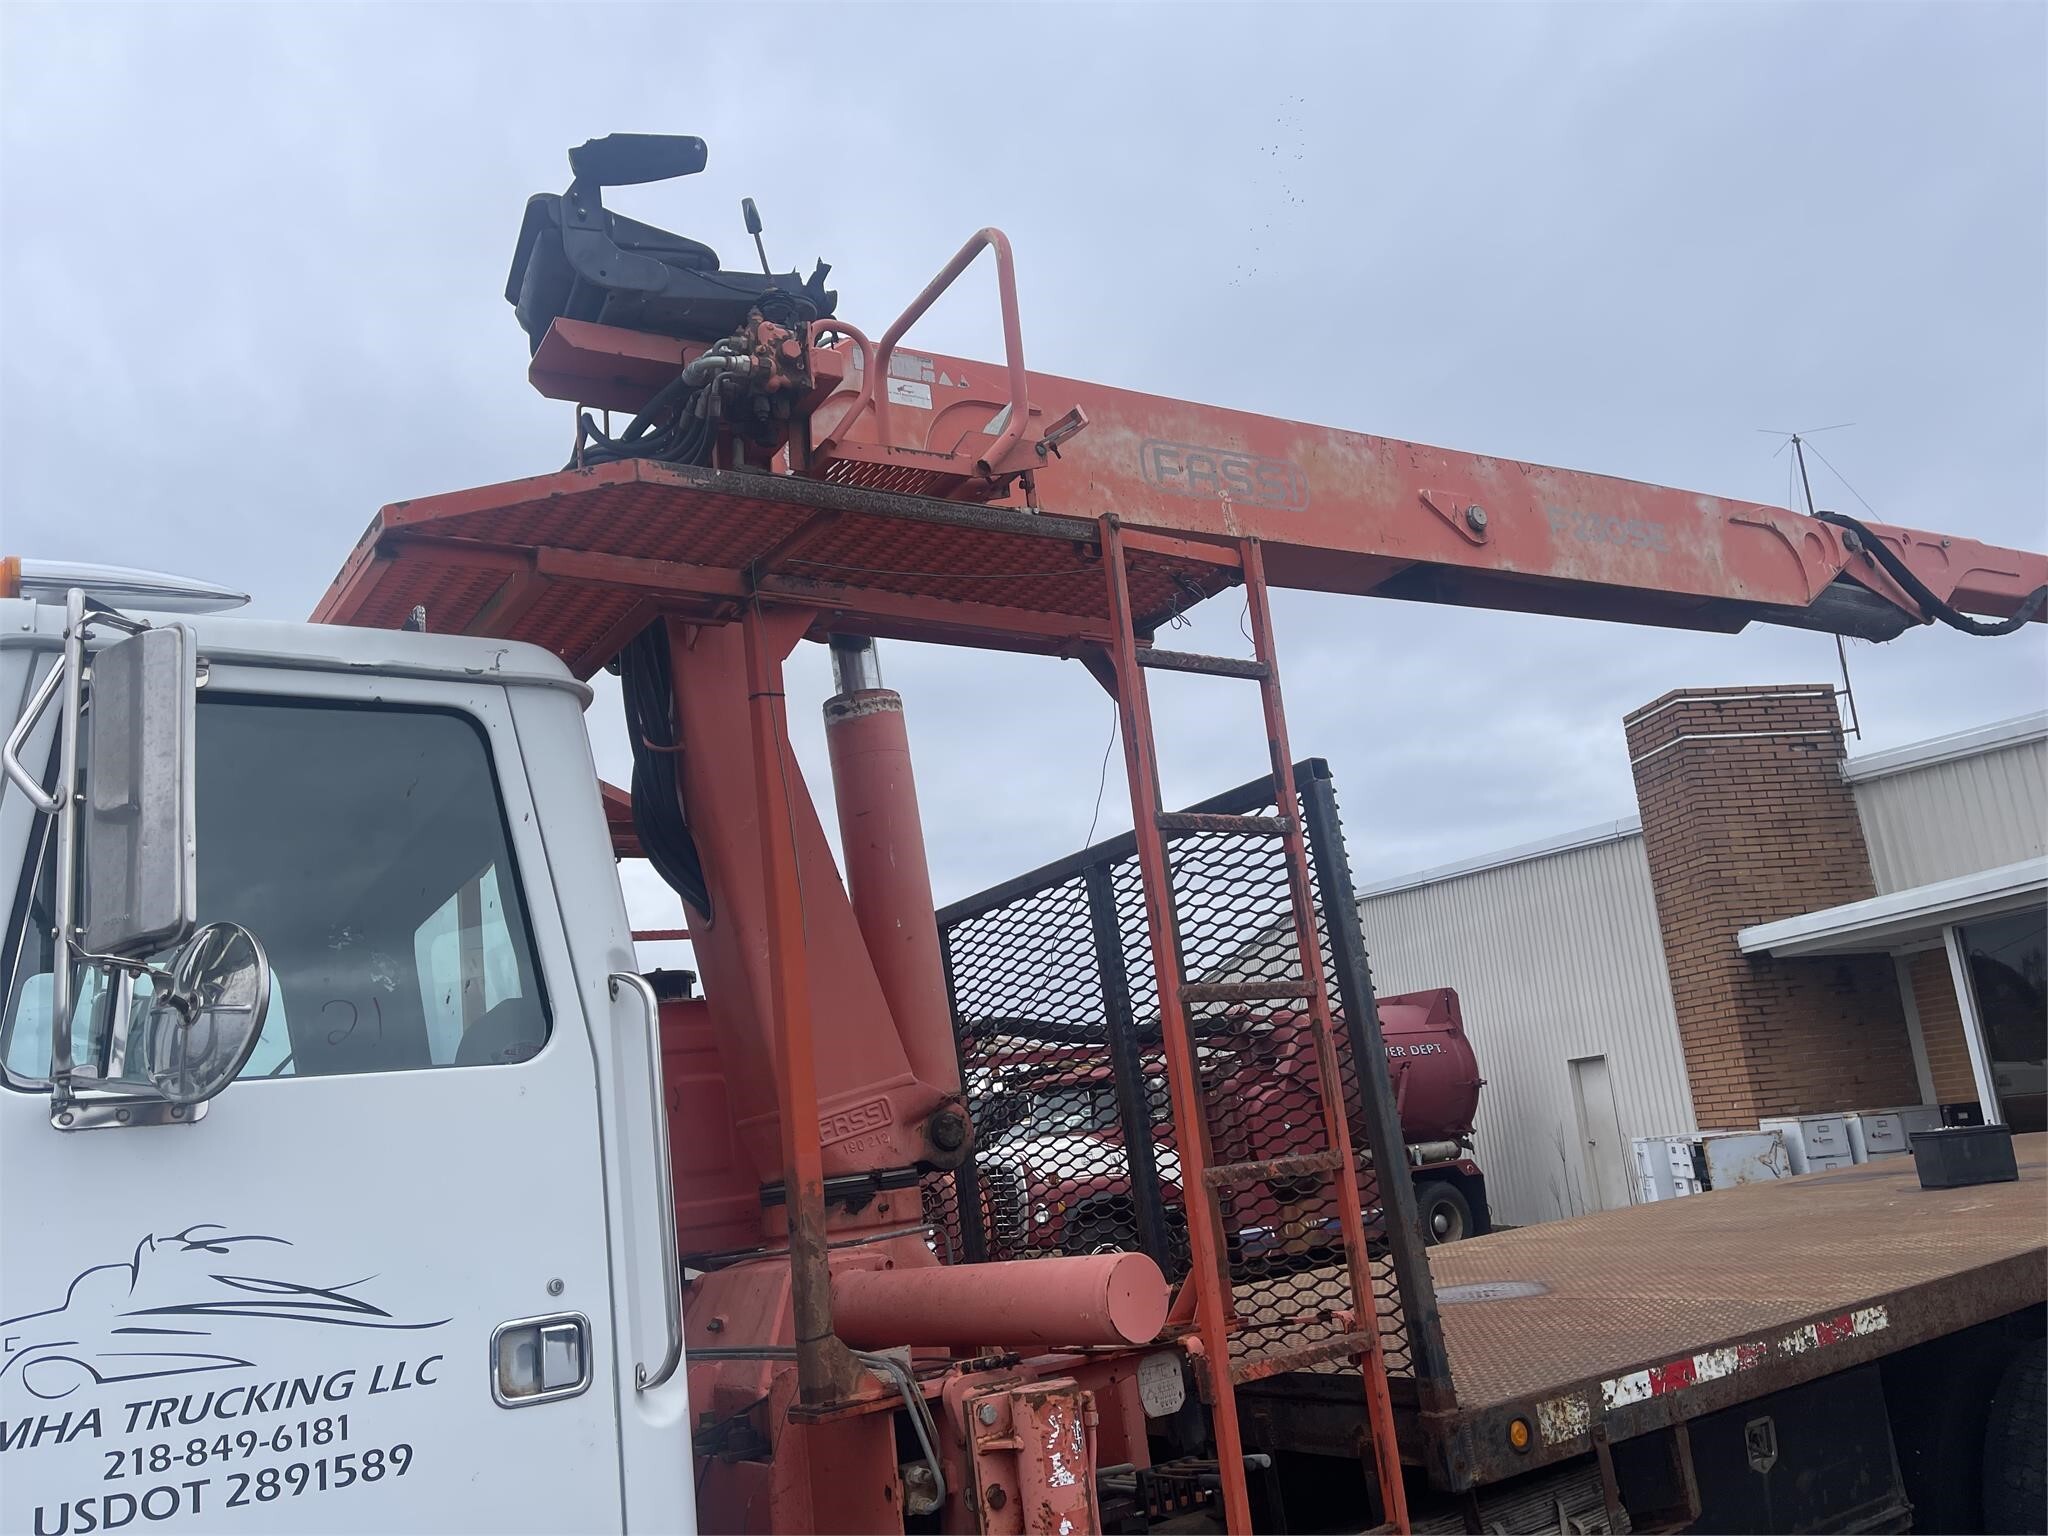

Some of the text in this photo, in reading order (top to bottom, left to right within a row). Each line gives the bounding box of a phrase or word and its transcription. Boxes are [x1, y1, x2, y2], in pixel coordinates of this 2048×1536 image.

[1152, 447, 1298, 504] FASSI
[322, 997, 382, 1046] 21
[1409, 1043, 1447, 1056] DEPT.
[819, 1102, 889, 1142] FASSI
[0, 1354, 444, 1452] MHA TRUCKING LLC
[103, 1413, 350, 1481] 218-849-6181
[33, 1442, 415, 1536] USDOT 2891589
